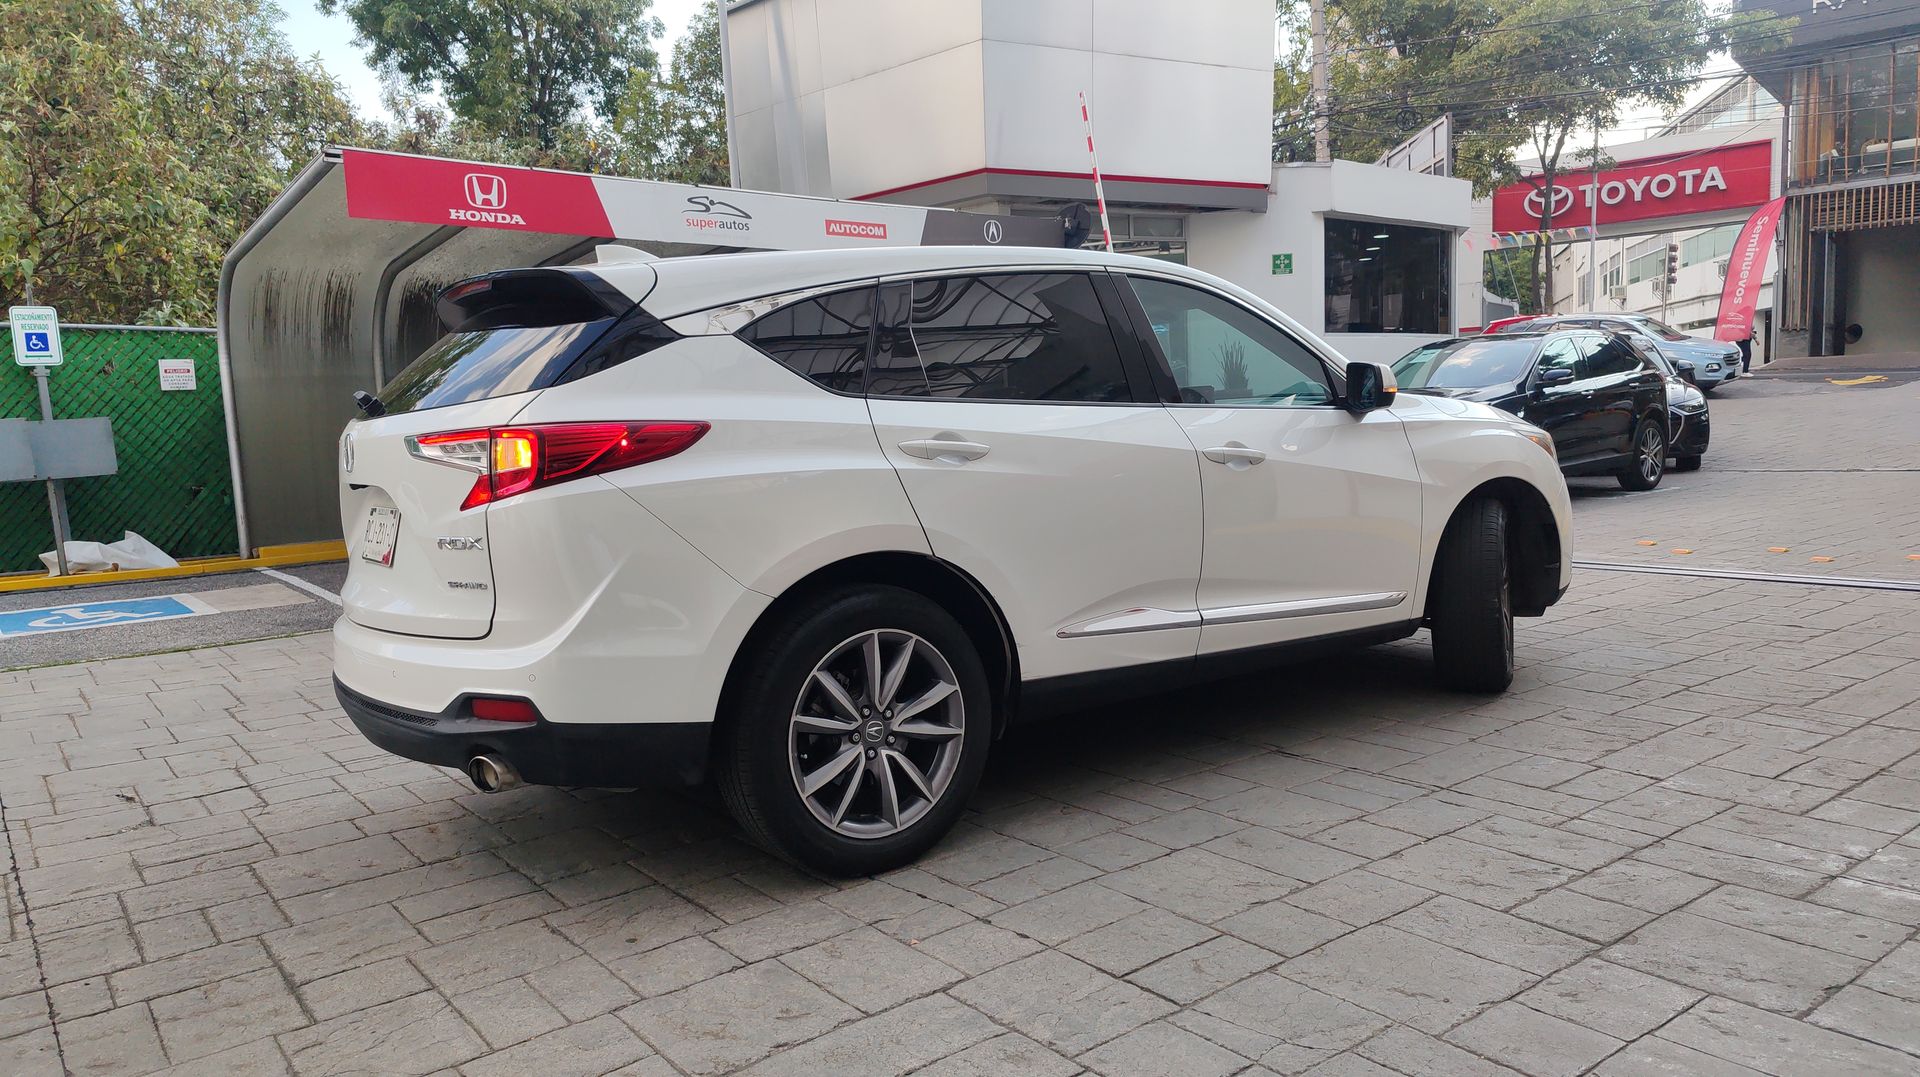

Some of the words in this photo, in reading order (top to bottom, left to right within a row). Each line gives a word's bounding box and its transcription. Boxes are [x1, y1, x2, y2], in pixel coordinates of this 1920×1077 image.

[1579, 166, 1727, 208] TOYOTA
[449, 208, 527, 225] HONDA
[686, 218, 750, 231] superautos
[829, 223, 885, 236] AUTOCOM
[1733, 215, 1769, 305] Seminuevos
[20, 323, 49, 331] RESERVADO
[437, 536, 484, 551] RDX
